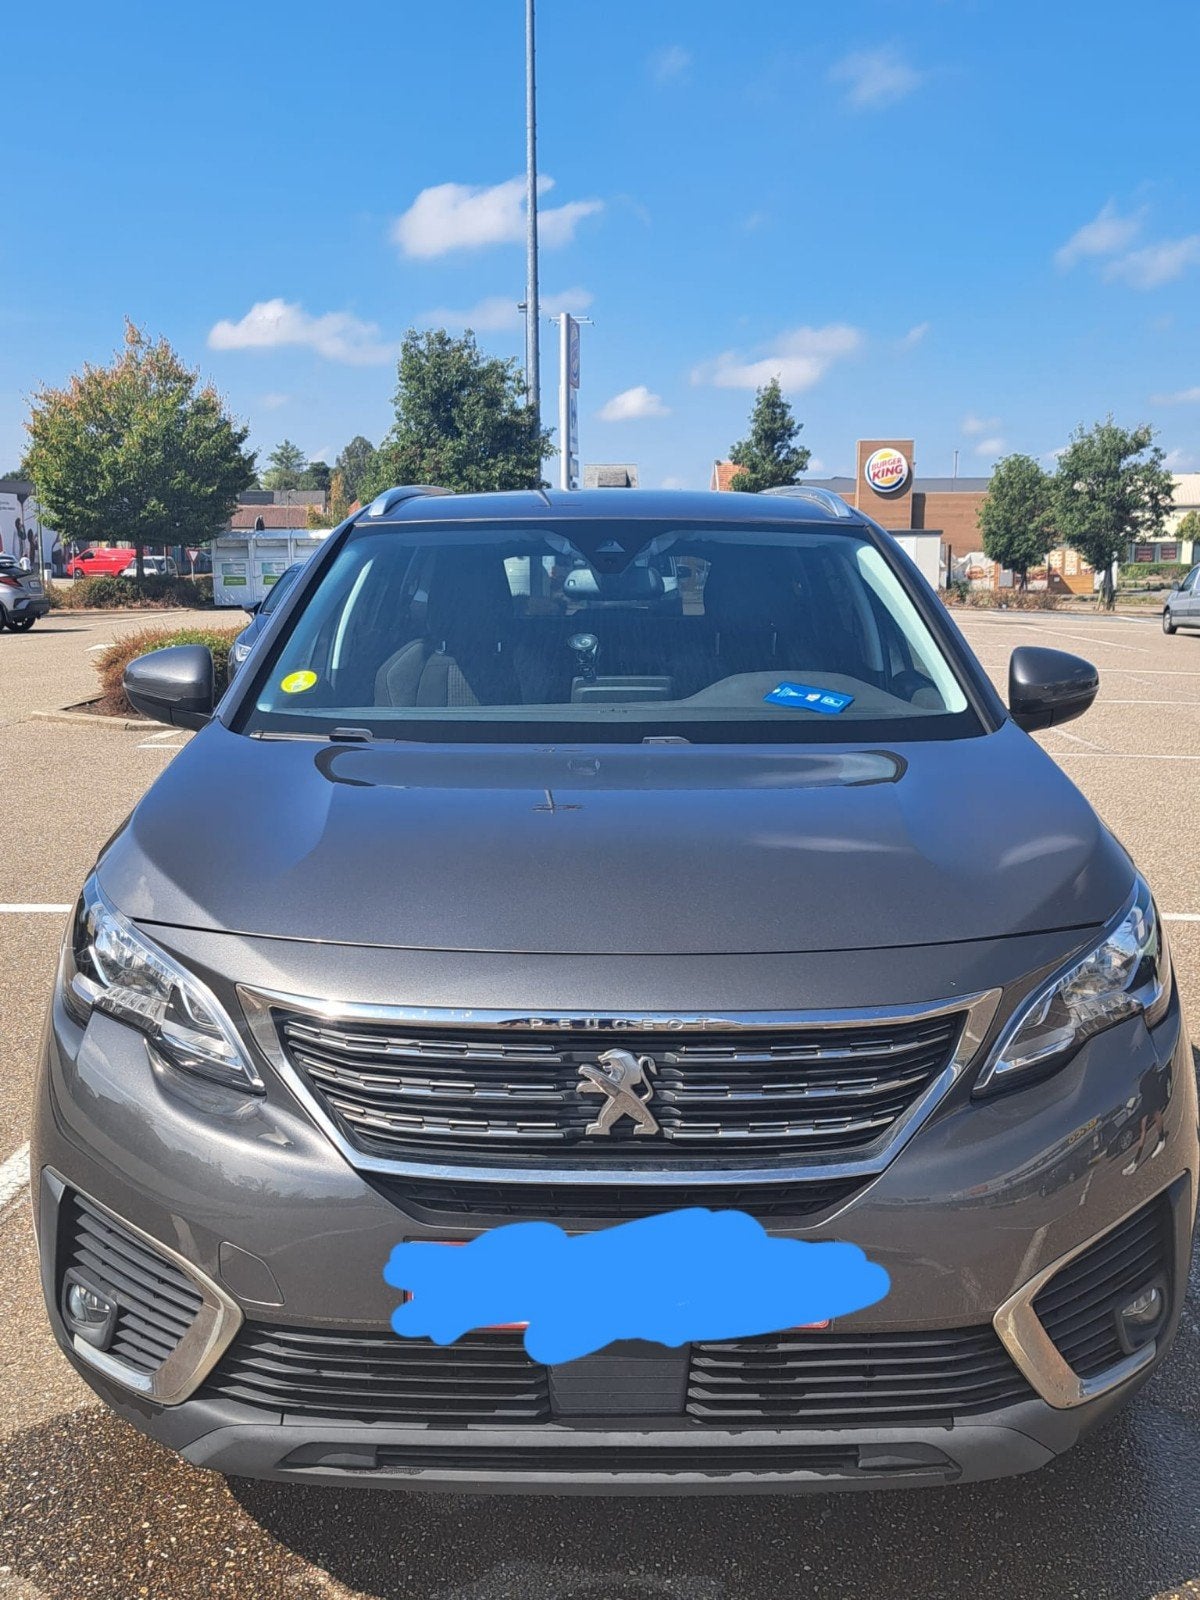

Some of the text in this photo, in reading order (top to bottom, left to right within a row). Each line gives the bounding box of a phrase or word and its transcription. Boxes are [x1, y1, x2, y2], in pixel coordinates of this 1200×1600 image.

[871, 457, 902, 471] BURGER
[872, 464, 903, 481] KING
[529, 1017, 710, 1030] PEUGEOT
